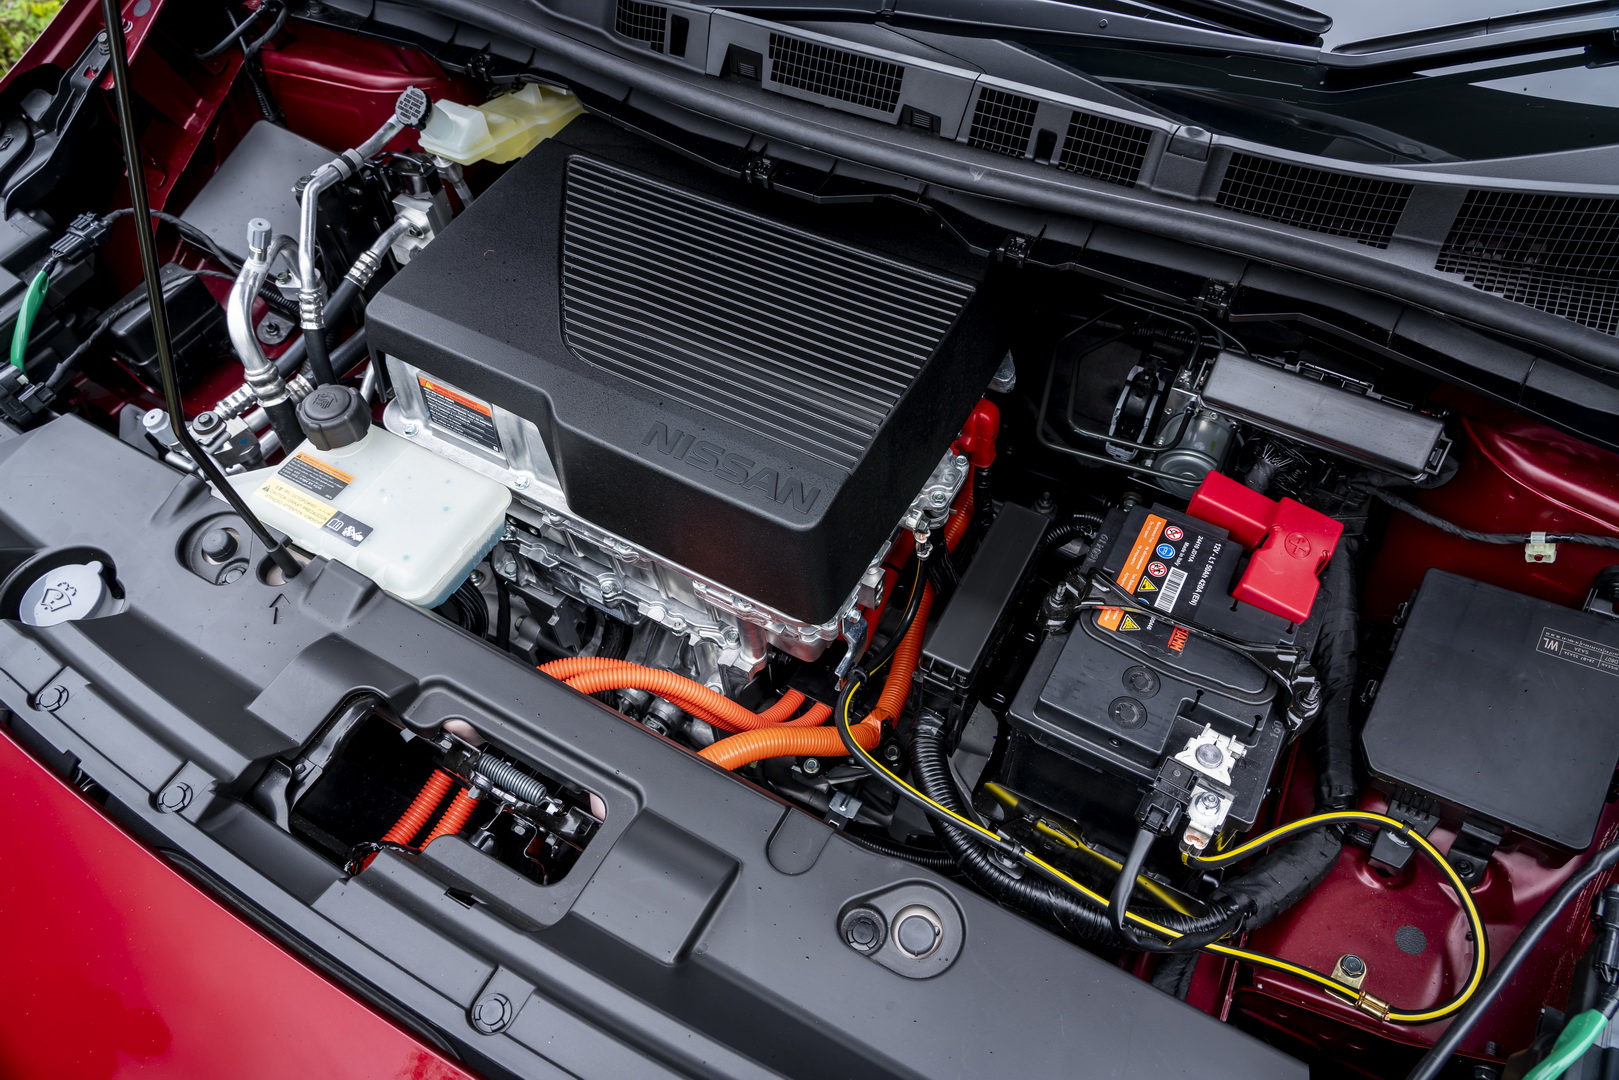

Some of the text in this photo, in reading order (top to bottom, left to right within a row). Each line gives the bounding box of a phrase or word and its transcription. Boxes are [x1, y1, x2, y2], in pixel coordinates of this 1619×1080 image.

[641, 420, 822, 515] NISSAN
[1181, 542, 1189, 553] Made
[1213, 543, 1221, 554] 12V
[1174, 557, 1182, 566] Italy
[1208, 556, 1216, 564] L1
[1202, 564, 1212, 578] 50Ah
[1195, 579, 1206, 592] 420A
[1189, 592, 1200, 606] (EN)
[1544, 638, 1558, 651] WL
